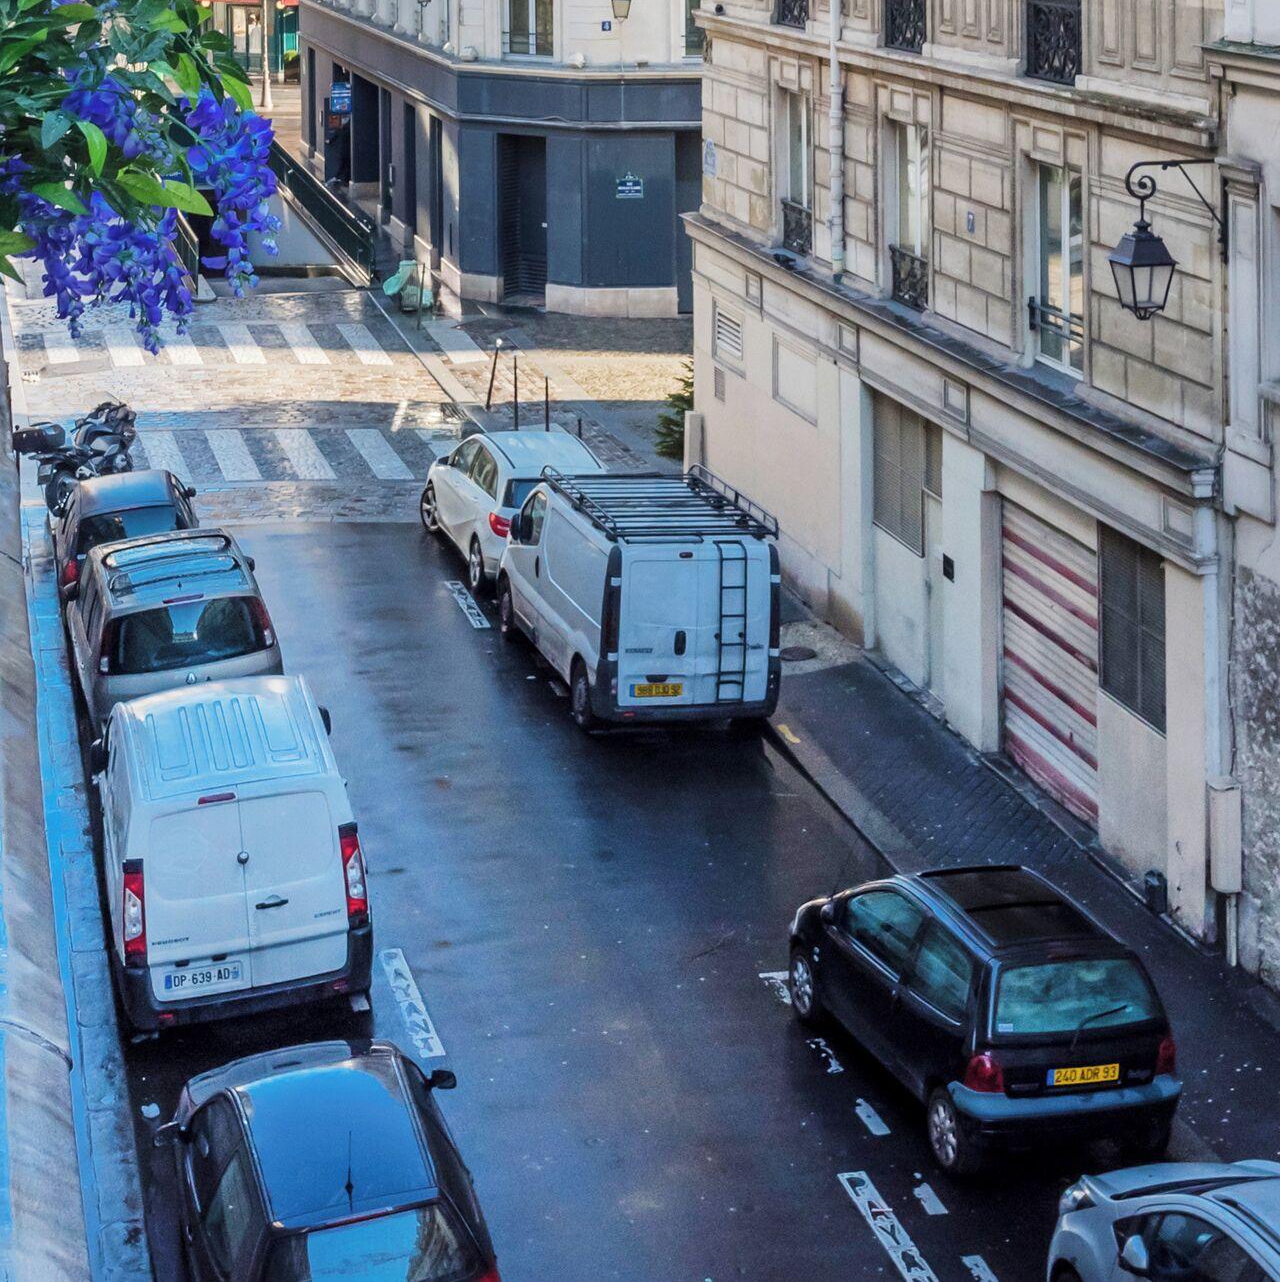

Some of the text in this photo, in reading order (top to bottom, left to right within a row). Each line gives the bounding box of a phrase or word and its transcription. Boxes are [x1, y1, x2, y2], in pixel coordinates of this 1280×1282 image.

[151, 936, 190, 946] PEUGEOT
[1055, 1069, 1077, 1083] 240
[1080, 1067, 1100, 1081] ADR
[1103, 1065, 1118, 1079] 93
